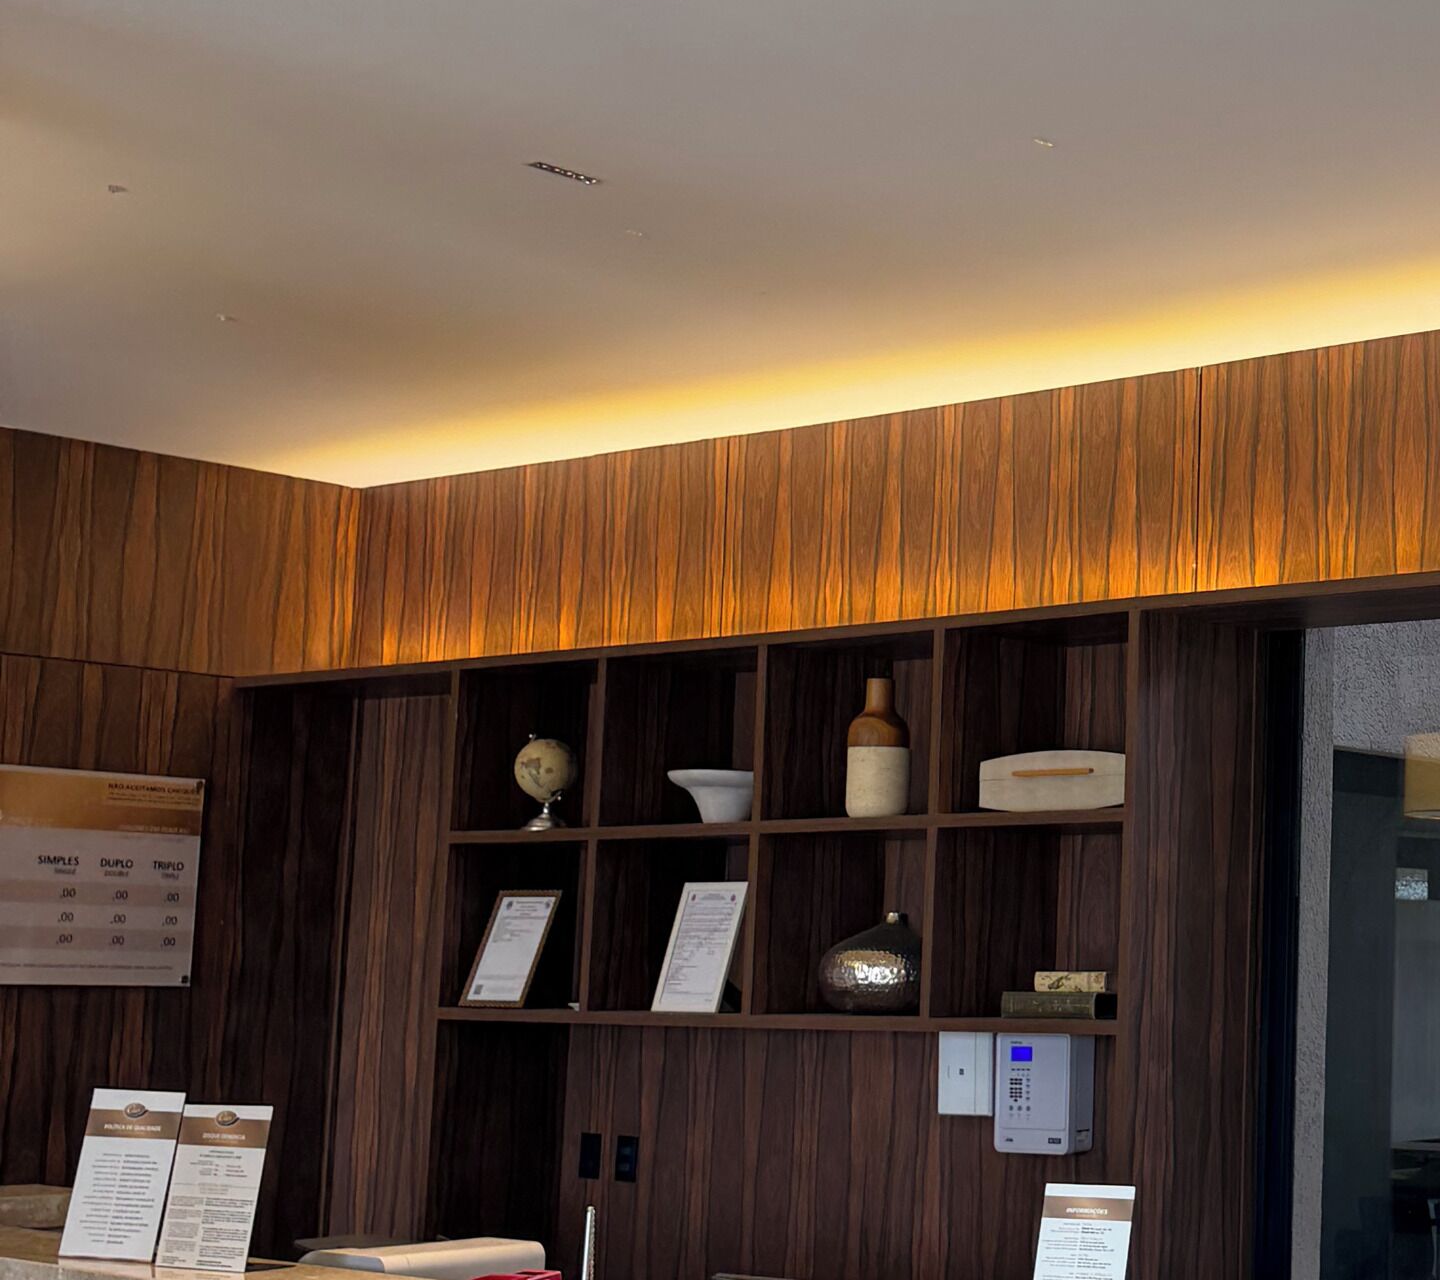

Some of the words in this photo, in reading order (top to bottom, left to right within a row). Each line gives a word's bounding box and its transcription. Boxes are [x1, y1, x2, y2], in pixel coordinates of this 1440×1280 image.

[37, 855, 80, 867] SIMPLES
[100, 857, 134, 869] DUPLO
[152, 860, 185, 871] TRIPLO
